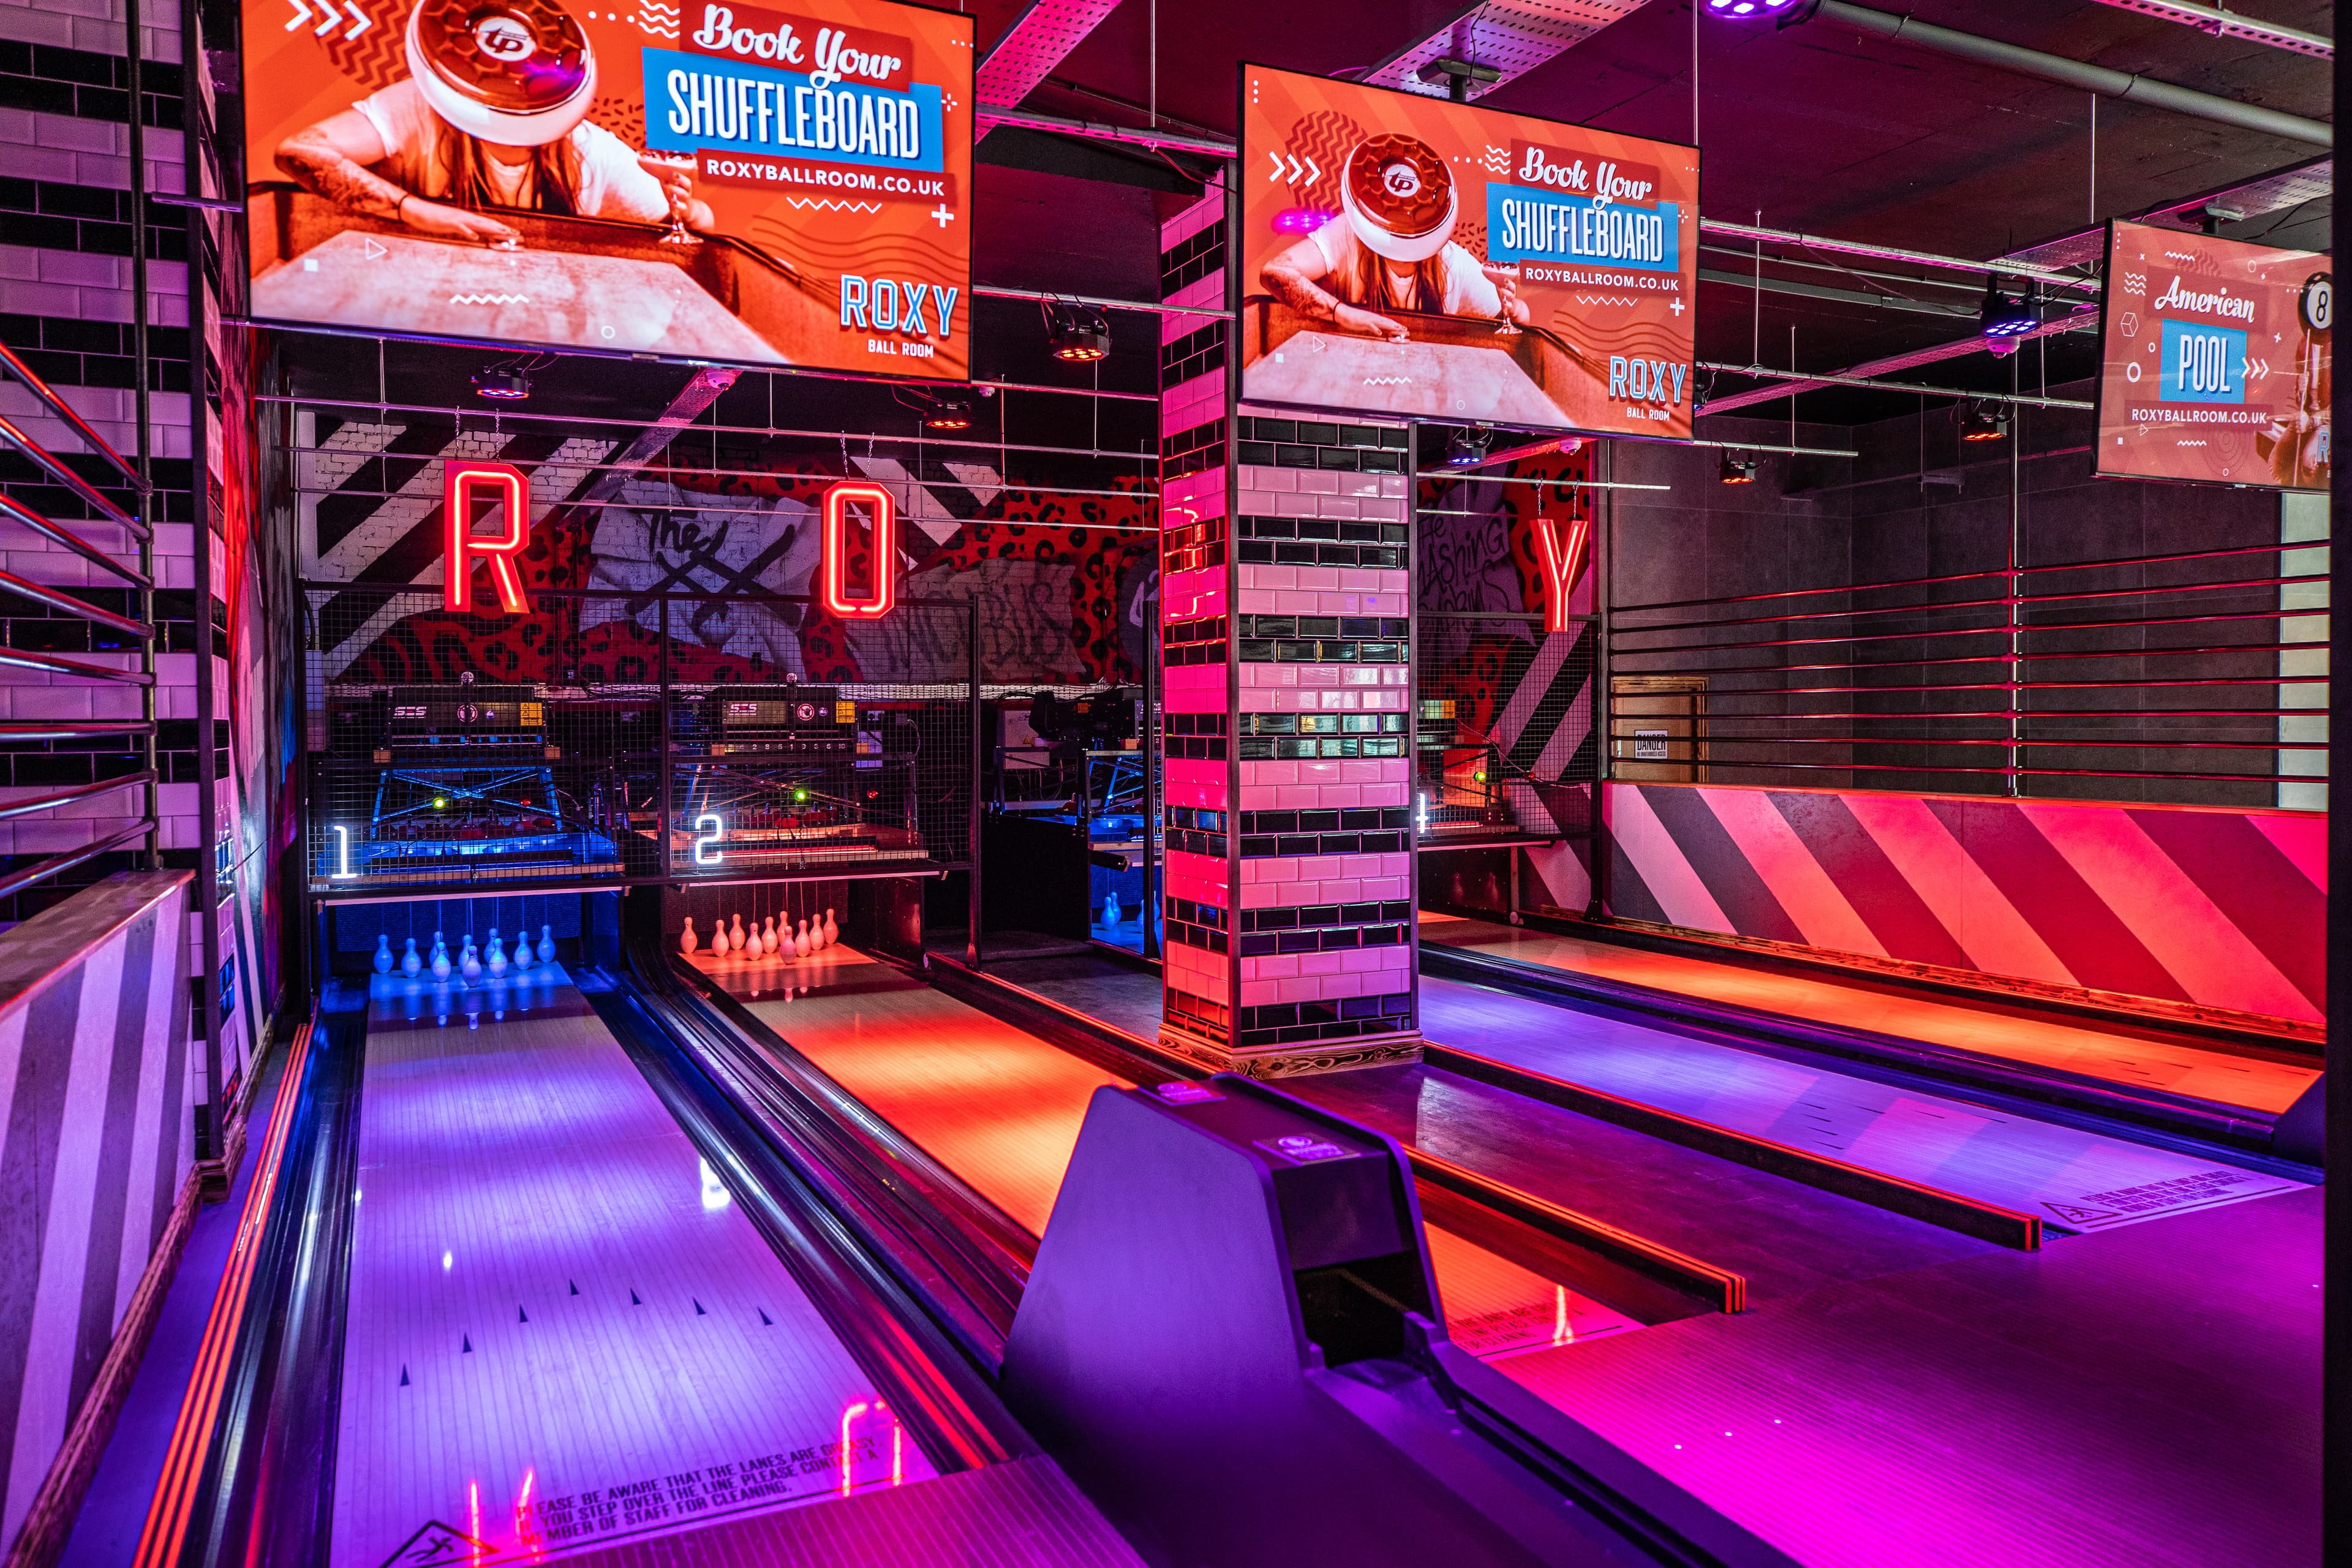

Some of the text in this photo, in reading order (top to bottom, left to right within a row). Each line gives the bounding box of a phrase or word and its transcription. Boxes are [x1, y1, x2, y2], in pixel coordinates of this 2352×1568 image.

[693, 4, 902, 89] Book Your
[667, 69, 921, 159] SHUFFLEBOARD
[706, 159, 944, 196] ROXYBALLROOM.CO.UK
[1519, 147, 1652, 211] Book Your
[1502, 198, 1664, 262] SHUFFLEBOARD
[1526, 267, 1679, 291] ROXYBALLROOM.CO.UK
[2154, 275, 2255, 323] American
[840, 274, 959, 337] ROXY
[868, 339, 933, 358] BALL ROOM
[2178, 334, 2231, 393] POOL
[1609, 356, 1686, 404] ROXY
[1627, 407, 1670, 421] BALL ROOM
[2132, 408, 2267, 424] ROXYBALLROOM.CO.UK
[1637, 734, 1666, 750] DANGER
[331, 825, 357, 879] 1
[695, 814, 723, 864] 2
[541, 1512, 574, 1528] YOU
[578, 1502, 617, 1521] STEP
[624, 1492, 665, 1511] OVER
[669, 1485, 699, 1502] THE
[702, 1477, 738, 1495] LINE
[741, 1464, 799, 1486] PLEASE
[582, 1489, 603, 1505] BE
[609, 1478, 661, 1499] AWARE
[665, 1470, 703, 1488] THAT
[706, 1463, 736, 1479] THE
[739, 1453, 787, 1473] LANES
[790, 1447, 818, 1463] ARE
[598, 1515, 618, 1531] OF
[624, 1503, 671, 1526] STAFF
[676, 1496, 708, 1515] FOR
[711, 1480, 792, 1507] CLEANING.
